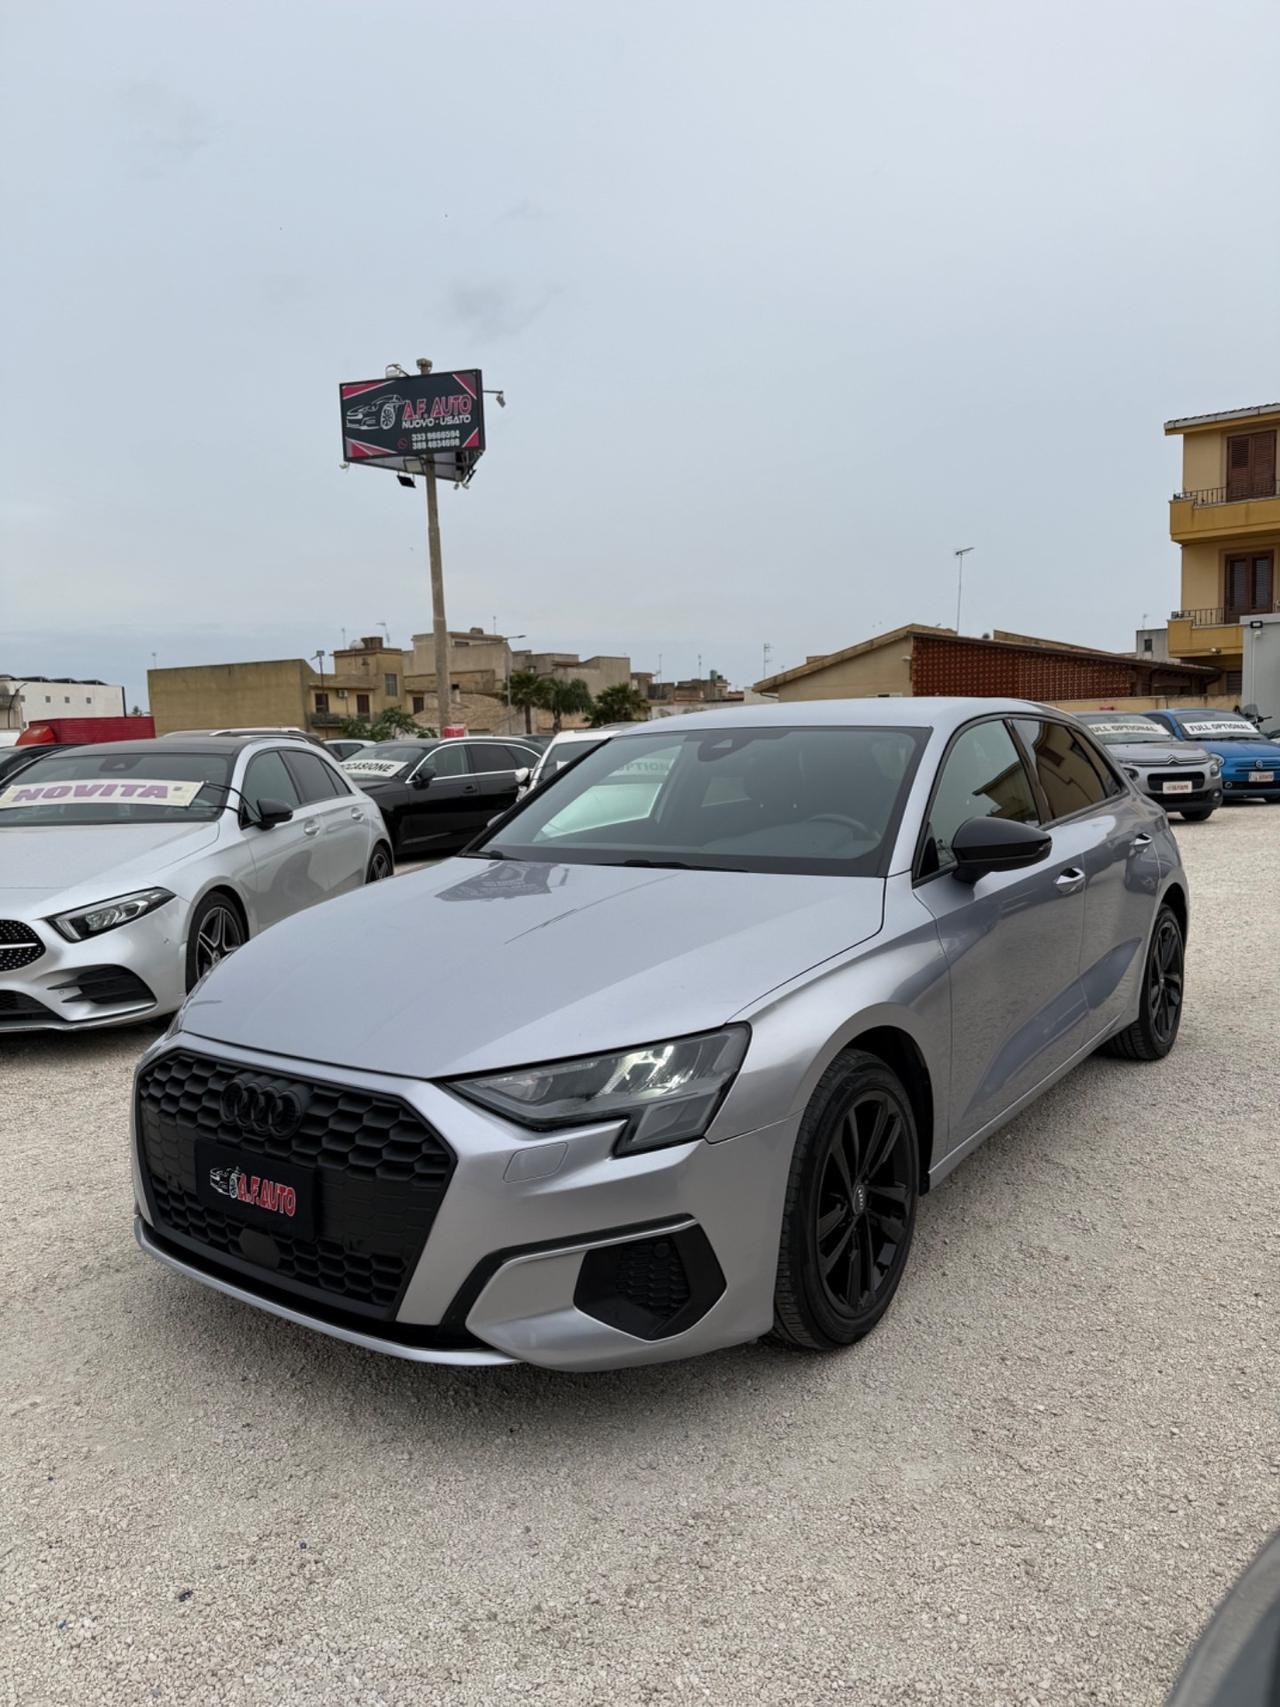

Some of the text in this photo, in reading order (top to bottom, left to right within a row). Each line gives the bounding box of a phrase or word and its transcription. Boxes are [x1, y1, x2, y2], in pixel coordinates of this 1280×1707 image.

[430, 394, 472, 417] AUTO
[402, 418, 435, 429] NUOVO
[440, 414, 471, 425] USATO
[1091, 724, 1159, 733] ULL OPTIONAL
[1189, 722, 1252, 732] FULL OPTIONAL
